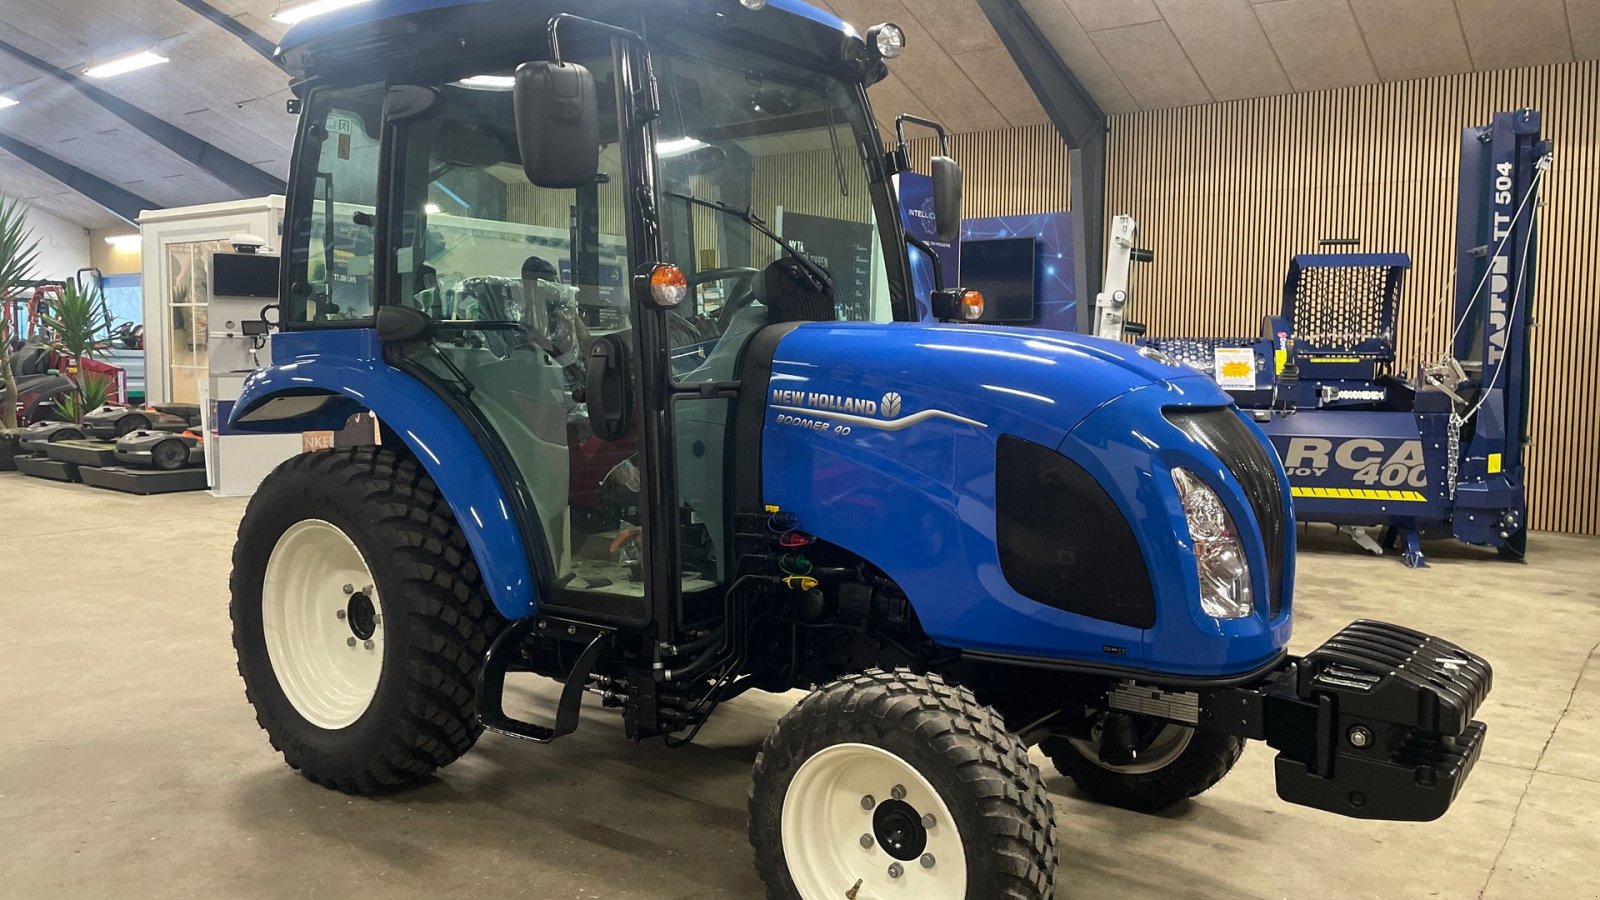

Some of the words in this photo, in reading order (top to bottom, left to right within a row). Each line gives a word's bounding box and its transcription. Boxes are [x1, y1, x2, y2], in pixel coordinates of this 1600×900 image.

[1496, 162, 1512, 205] 504
[1494, 212, 1510, 241] TT
[1488, 256, 1508, 365] TAJFUN
[773, 389, 805, 403] NEW
[808, 392, 877, 415] HOLLAND
[776, 414, 830, 431] BOOMER
[834, 425, 851, 436] 40
[1285, 438, 1424, 470] RCA
[1286, 467, 1328, 476] JOY
[1353, 463, 1427, 487] 400
